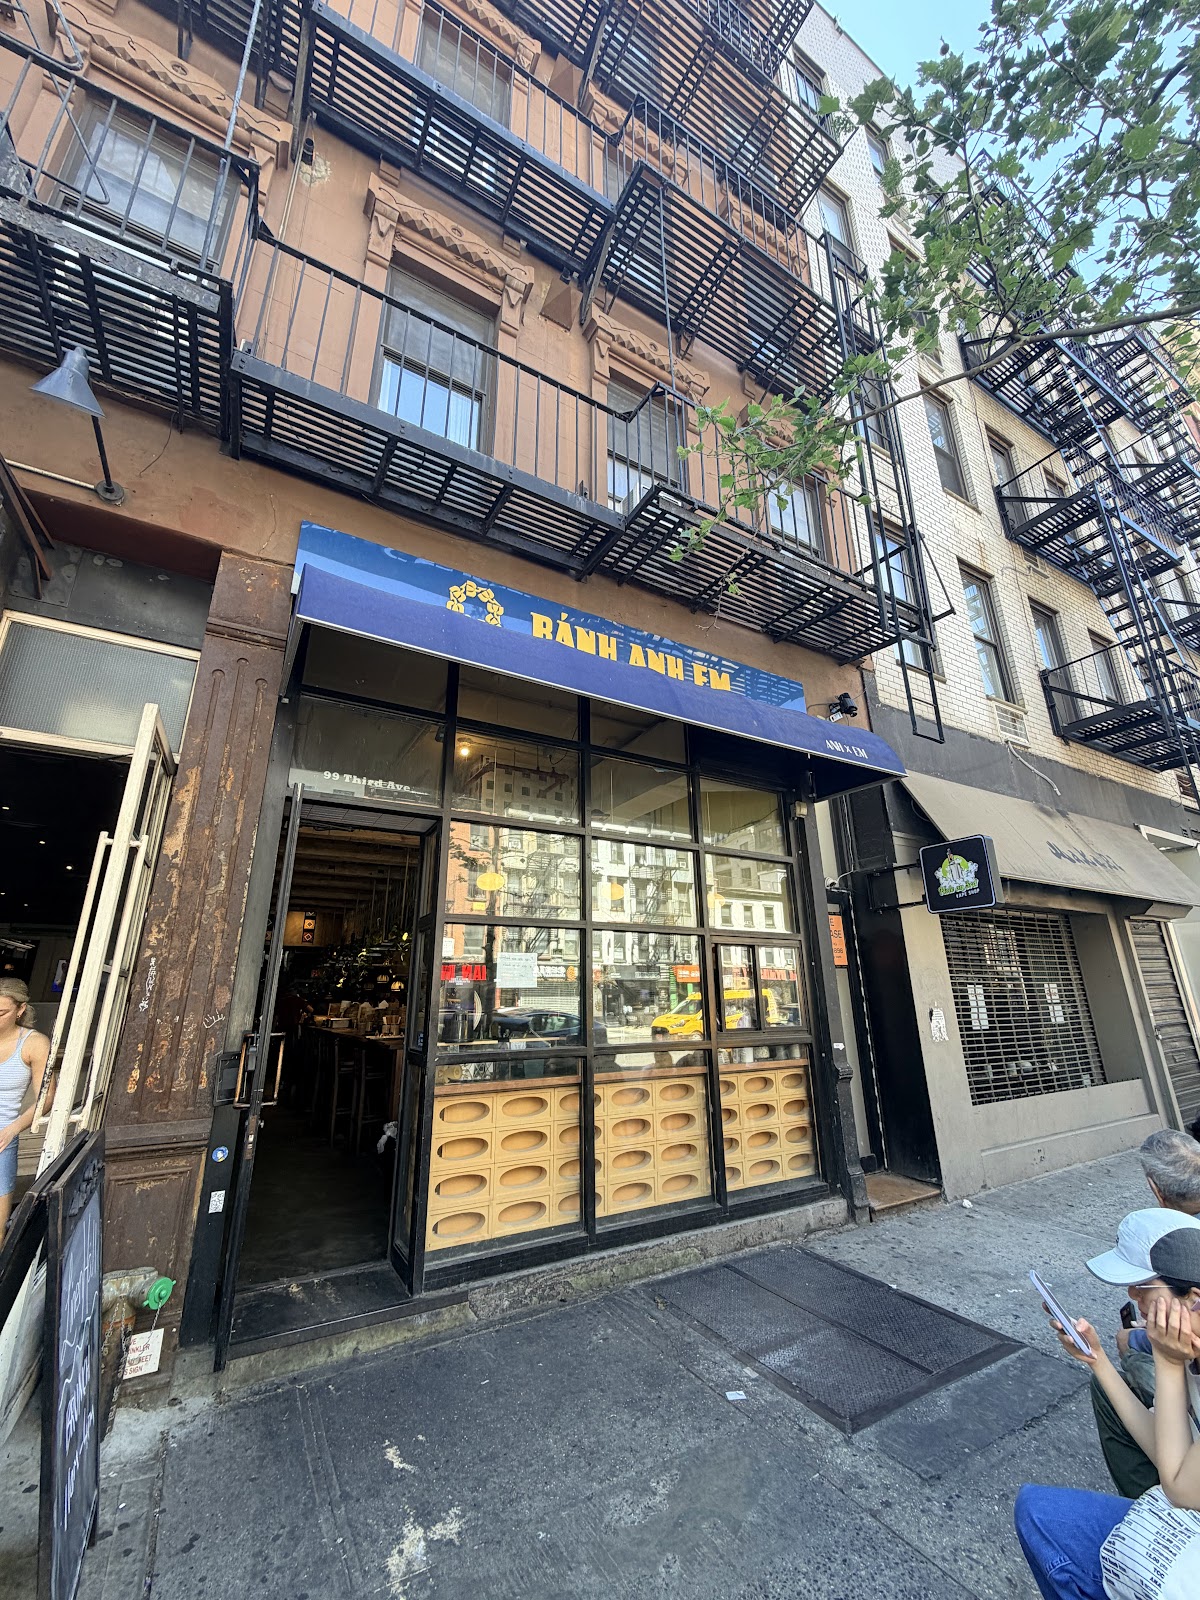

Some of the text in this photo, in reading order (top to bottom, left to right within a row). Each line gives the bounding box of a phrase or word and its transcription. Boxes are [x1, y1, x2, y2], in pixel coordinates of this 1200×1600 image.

[530, 612, 731, 691] BÁNH ANH EM
[323, 770, 340, 781] 99
[343, 773, 383, 788] Third
